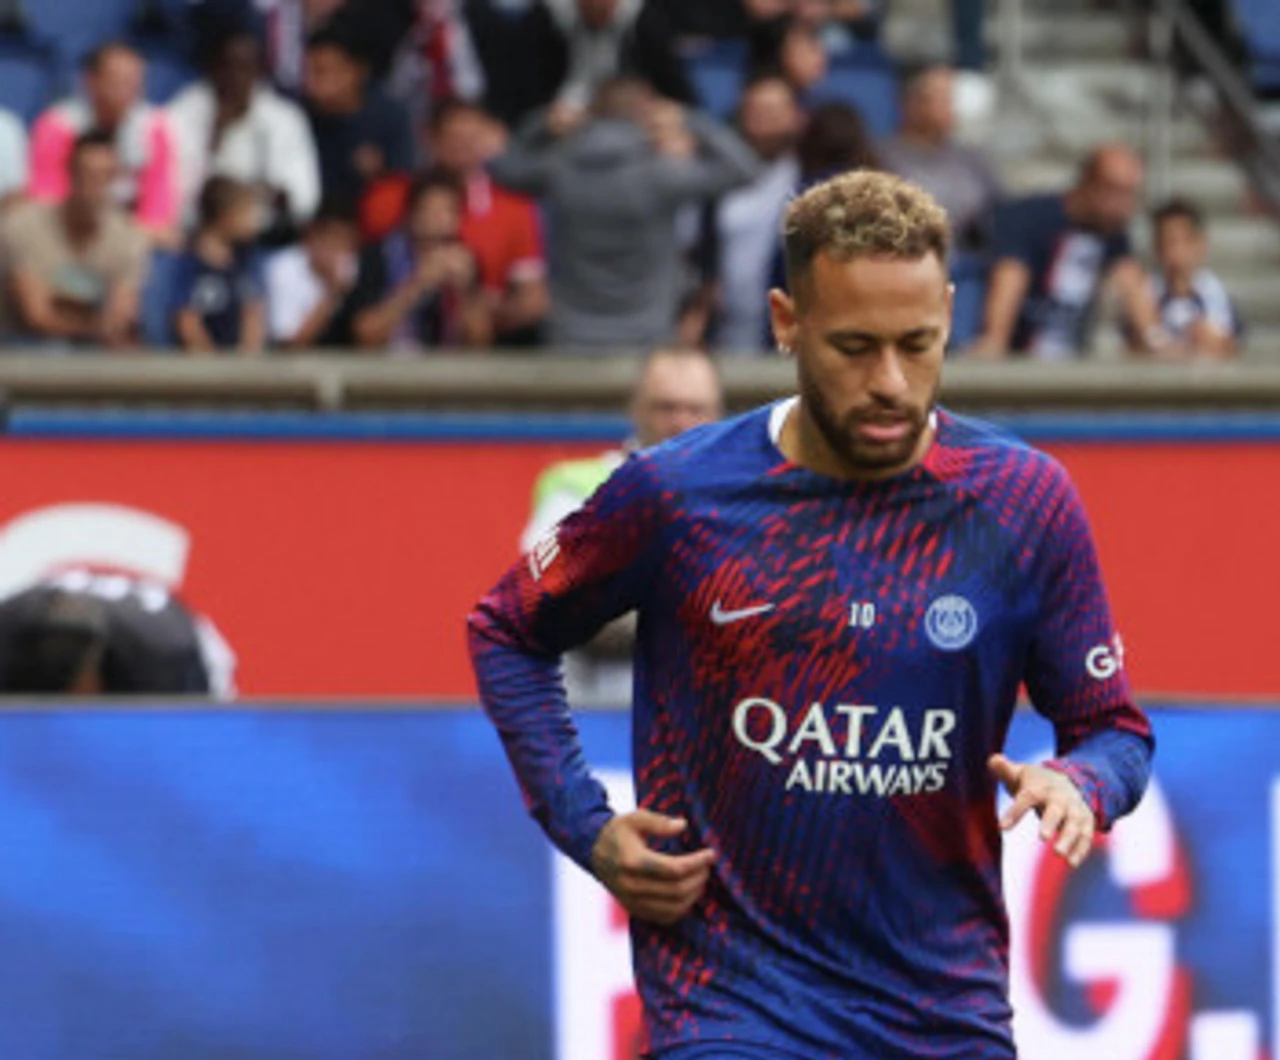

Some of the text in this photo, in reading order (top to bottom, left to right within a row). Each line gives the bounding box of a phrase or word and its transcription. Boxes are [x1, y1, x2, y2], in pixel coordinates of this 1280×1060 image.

[848, 601, 875, 629] 10
[732, 697, 956, 765] QATAR
[785, 758, 948, 797] AIRWAYS
